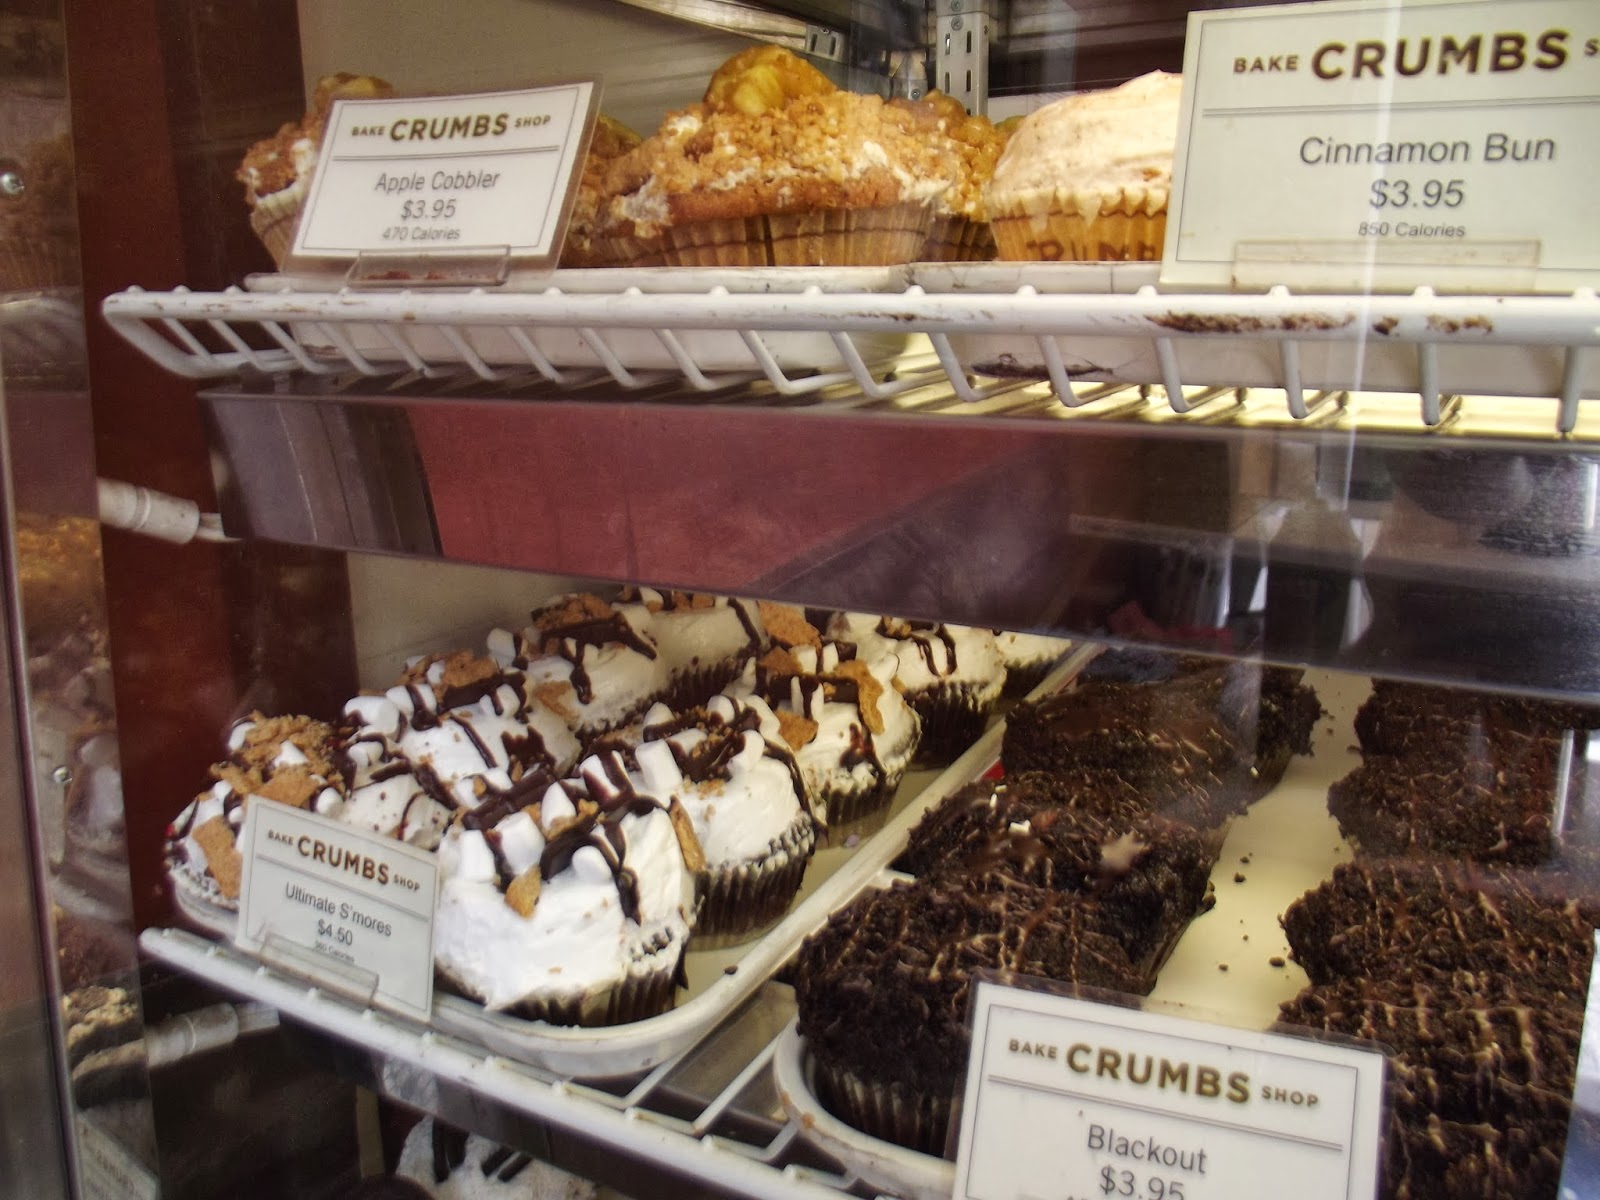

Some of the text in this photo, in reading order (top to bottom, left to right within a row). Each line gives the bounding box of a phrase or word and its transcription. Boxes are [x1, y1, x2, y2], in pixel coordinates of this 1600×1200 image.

[1233, 54, 1299, 74] BAKE
[1311, 29, 1570, 80] CRUMBS
[352, 113, 552, 142] BAKE CRUMBS SHOP
[1299, 133, 1556, 165] Cinnamon Bun
[375, 169, 501, 194] Apple Cobbler
[1369, 179, 1464, 208] $3.95
[401, 198, 457, 221] $3.95
[382, 225, 460, 241] 470 Calories
[1358, 220, 1466, 237] 850 Calories
[268, 829, 421, 892] BAKE CRUMBS SHOP
[285, 881, 393, 937] Ultimate S'mores
[317, 918, 353, 946] $4.50
[1008, 1037, 1320, 1108] BAKE CRUMBS SHOP
[1087, 1124, 1208, 1175] Blackout
[1099, 1164, 1185, 1200] $3.95
